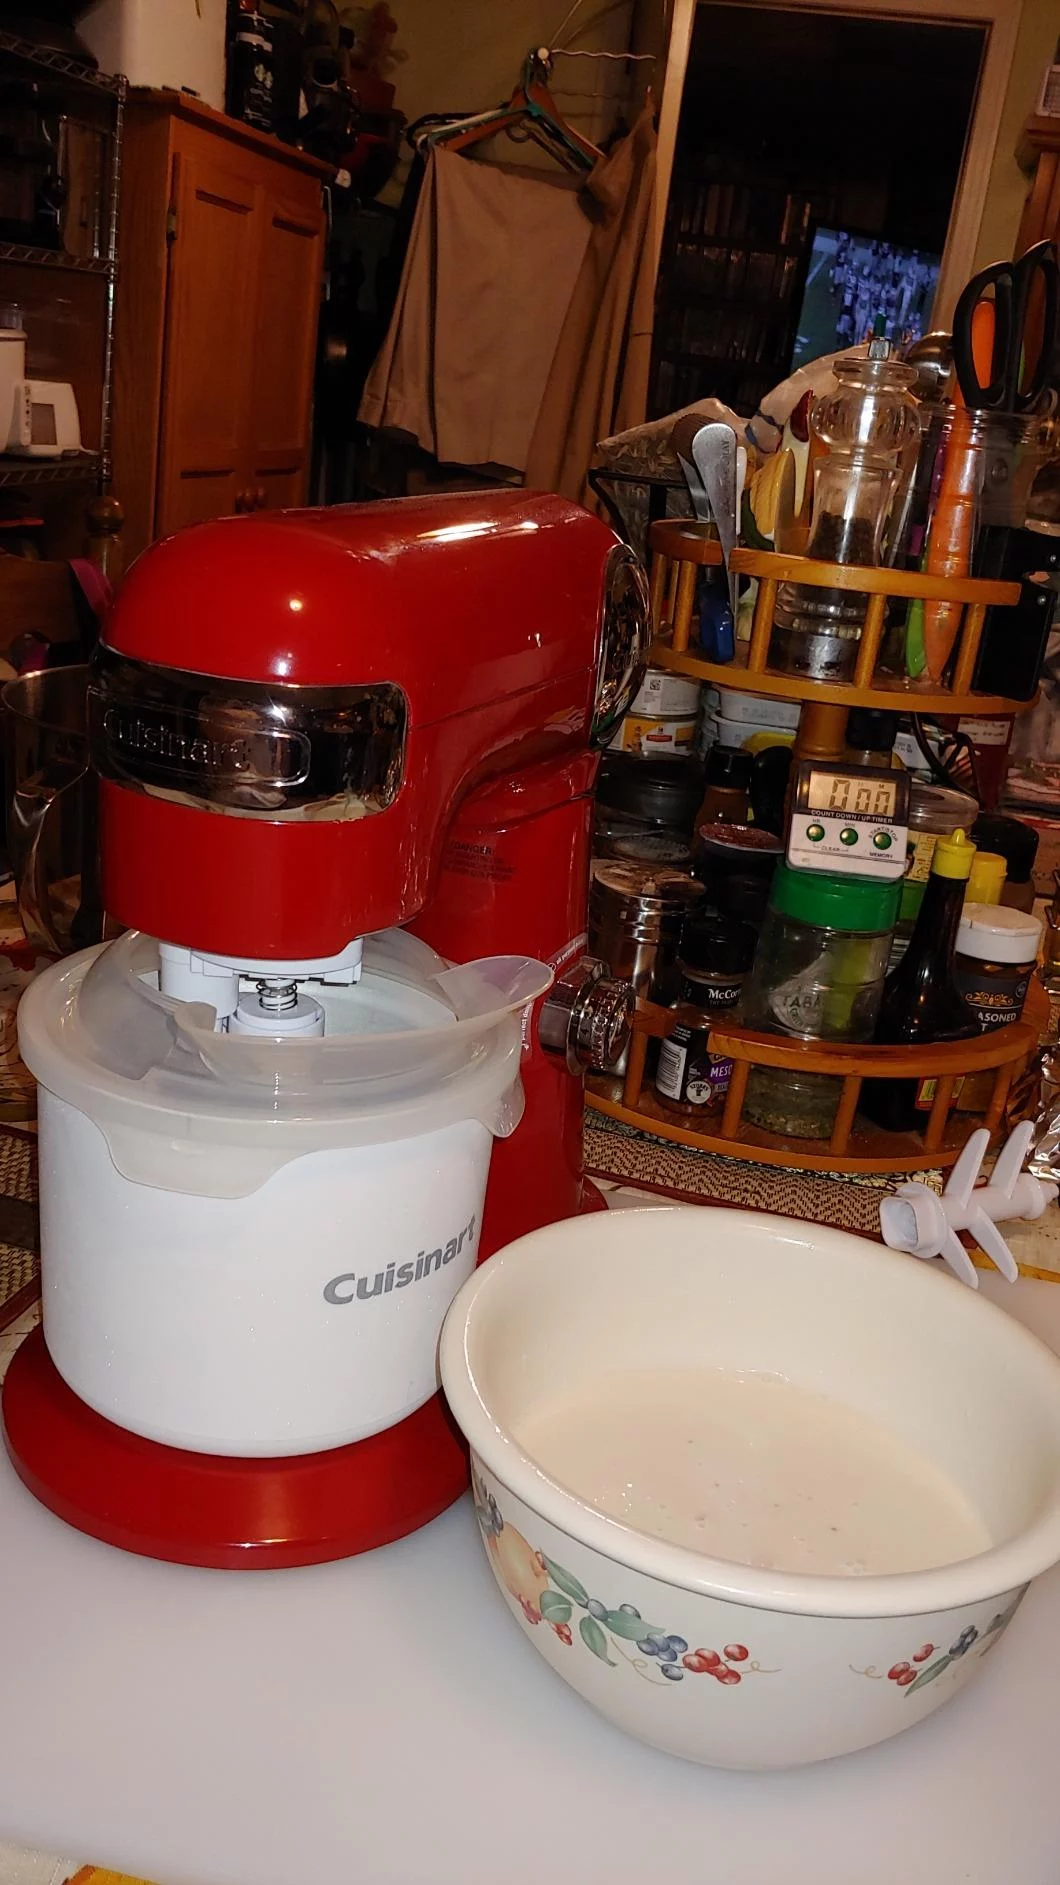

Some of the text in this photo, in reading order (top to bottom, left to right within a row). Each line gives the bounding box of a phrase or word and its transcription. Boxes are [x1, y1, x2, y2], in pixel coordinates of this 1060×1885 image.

[811, 810, 835, 818] COUNT
[835, 812, 857, 820] DOWN
[872, 816, 893, 824] TIMER
[782, 992, 821, 1008] TABA
[978, 1012, 1016, 1023] ASONED
[323, 1213, 475, 1305] Cuisinart
